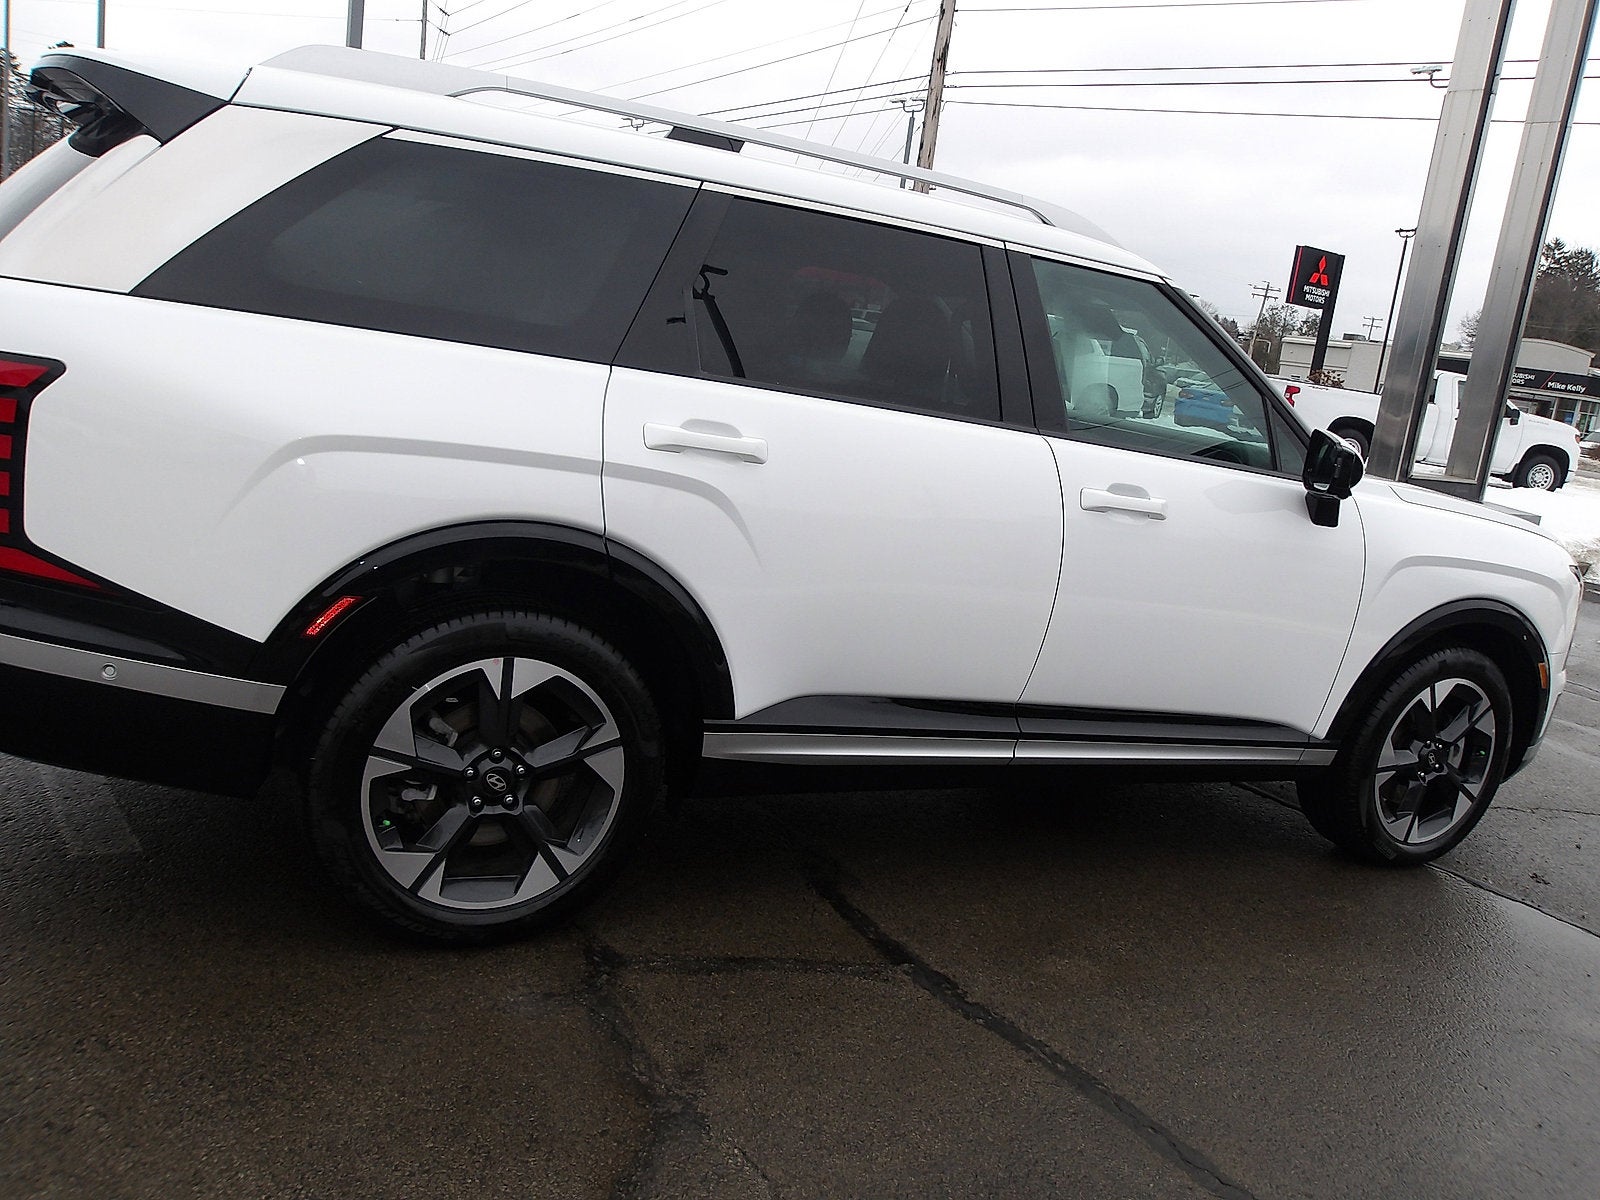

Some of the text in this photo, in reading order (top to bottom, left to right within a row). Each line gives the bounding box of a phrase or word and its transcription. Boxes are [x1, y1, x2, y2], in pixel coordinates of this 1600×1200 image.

[1303, 285, 1330, 297] MITSUBISHI
[1304, 294, 1325, 304] MOTORS
[1512, 372, 1536, 380] SUBISHI
[1547, 381, 1586, 393] Mike Kelly
